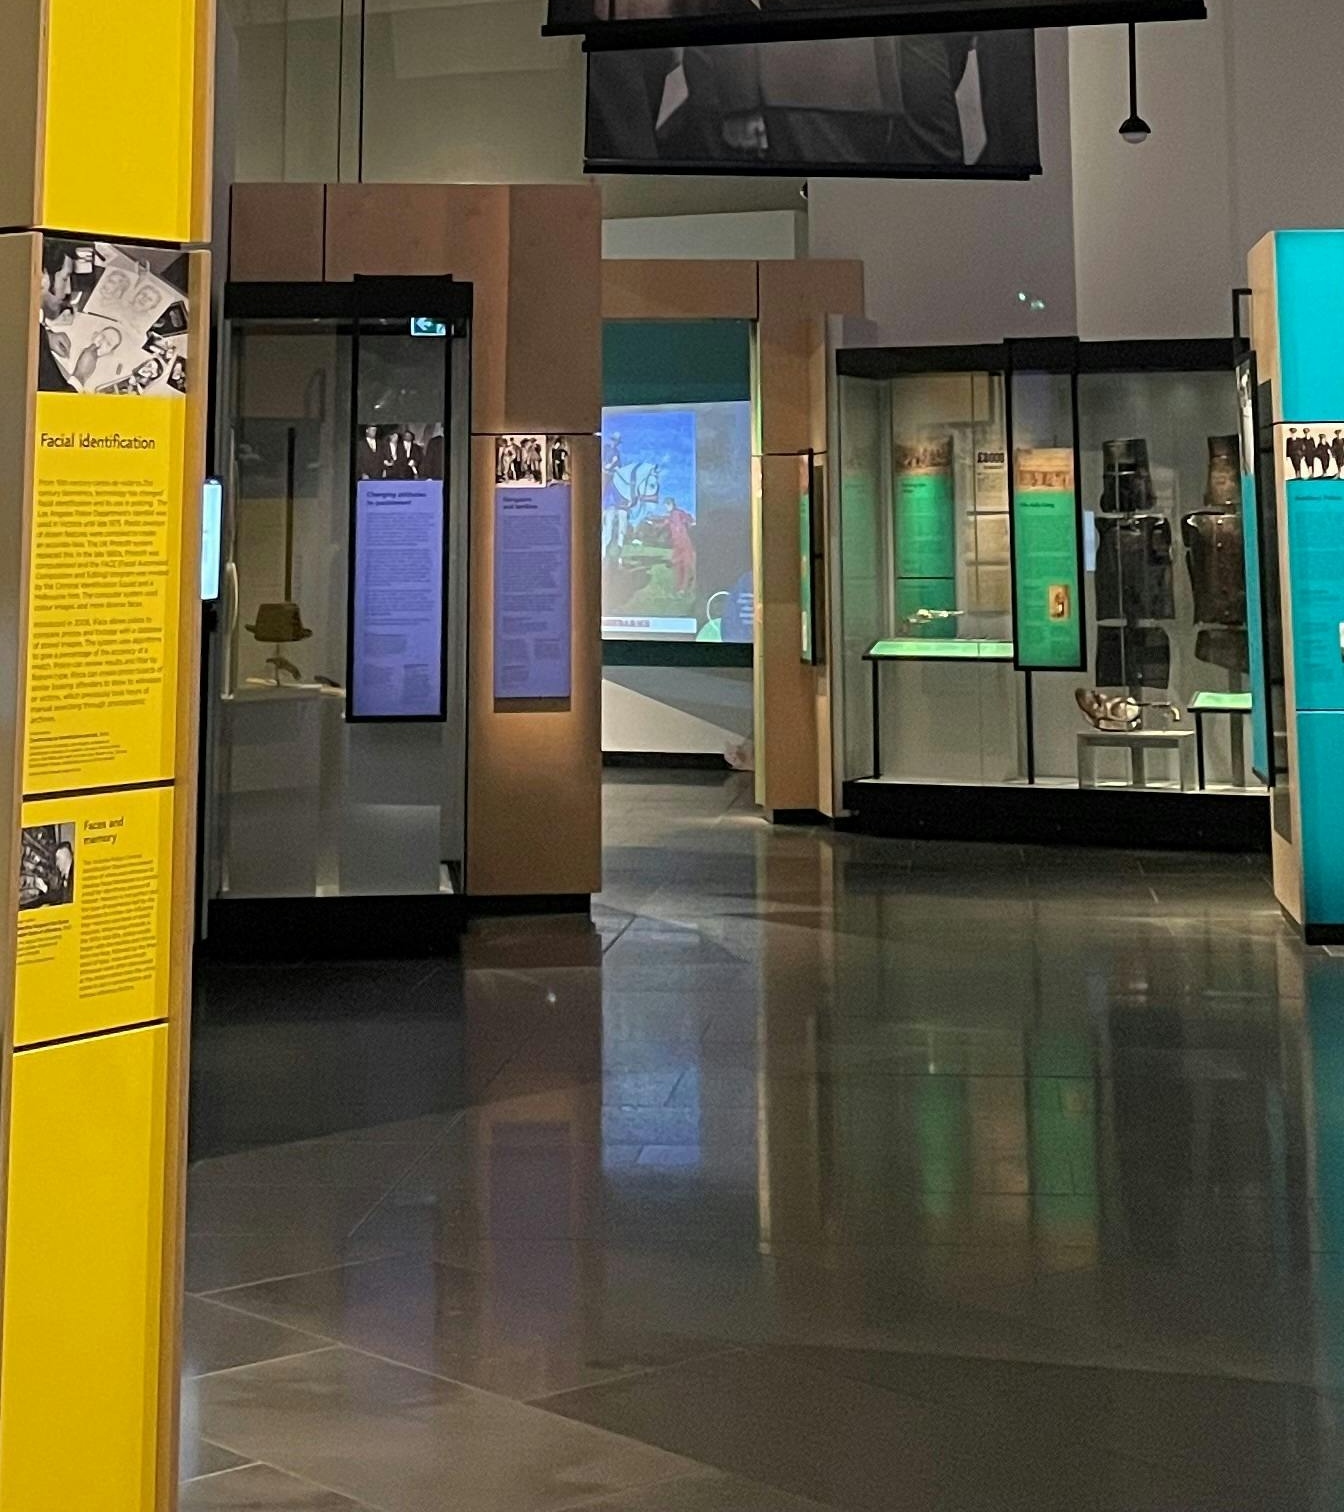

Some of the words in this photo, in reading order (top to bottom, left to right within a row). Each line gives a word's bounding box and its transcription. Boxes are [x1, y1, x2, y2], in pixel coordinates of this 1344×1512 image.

[40, 432, 75, 449] Facial
[79, 433, 156, 450] identification
[109, 816, 125, 829] and
